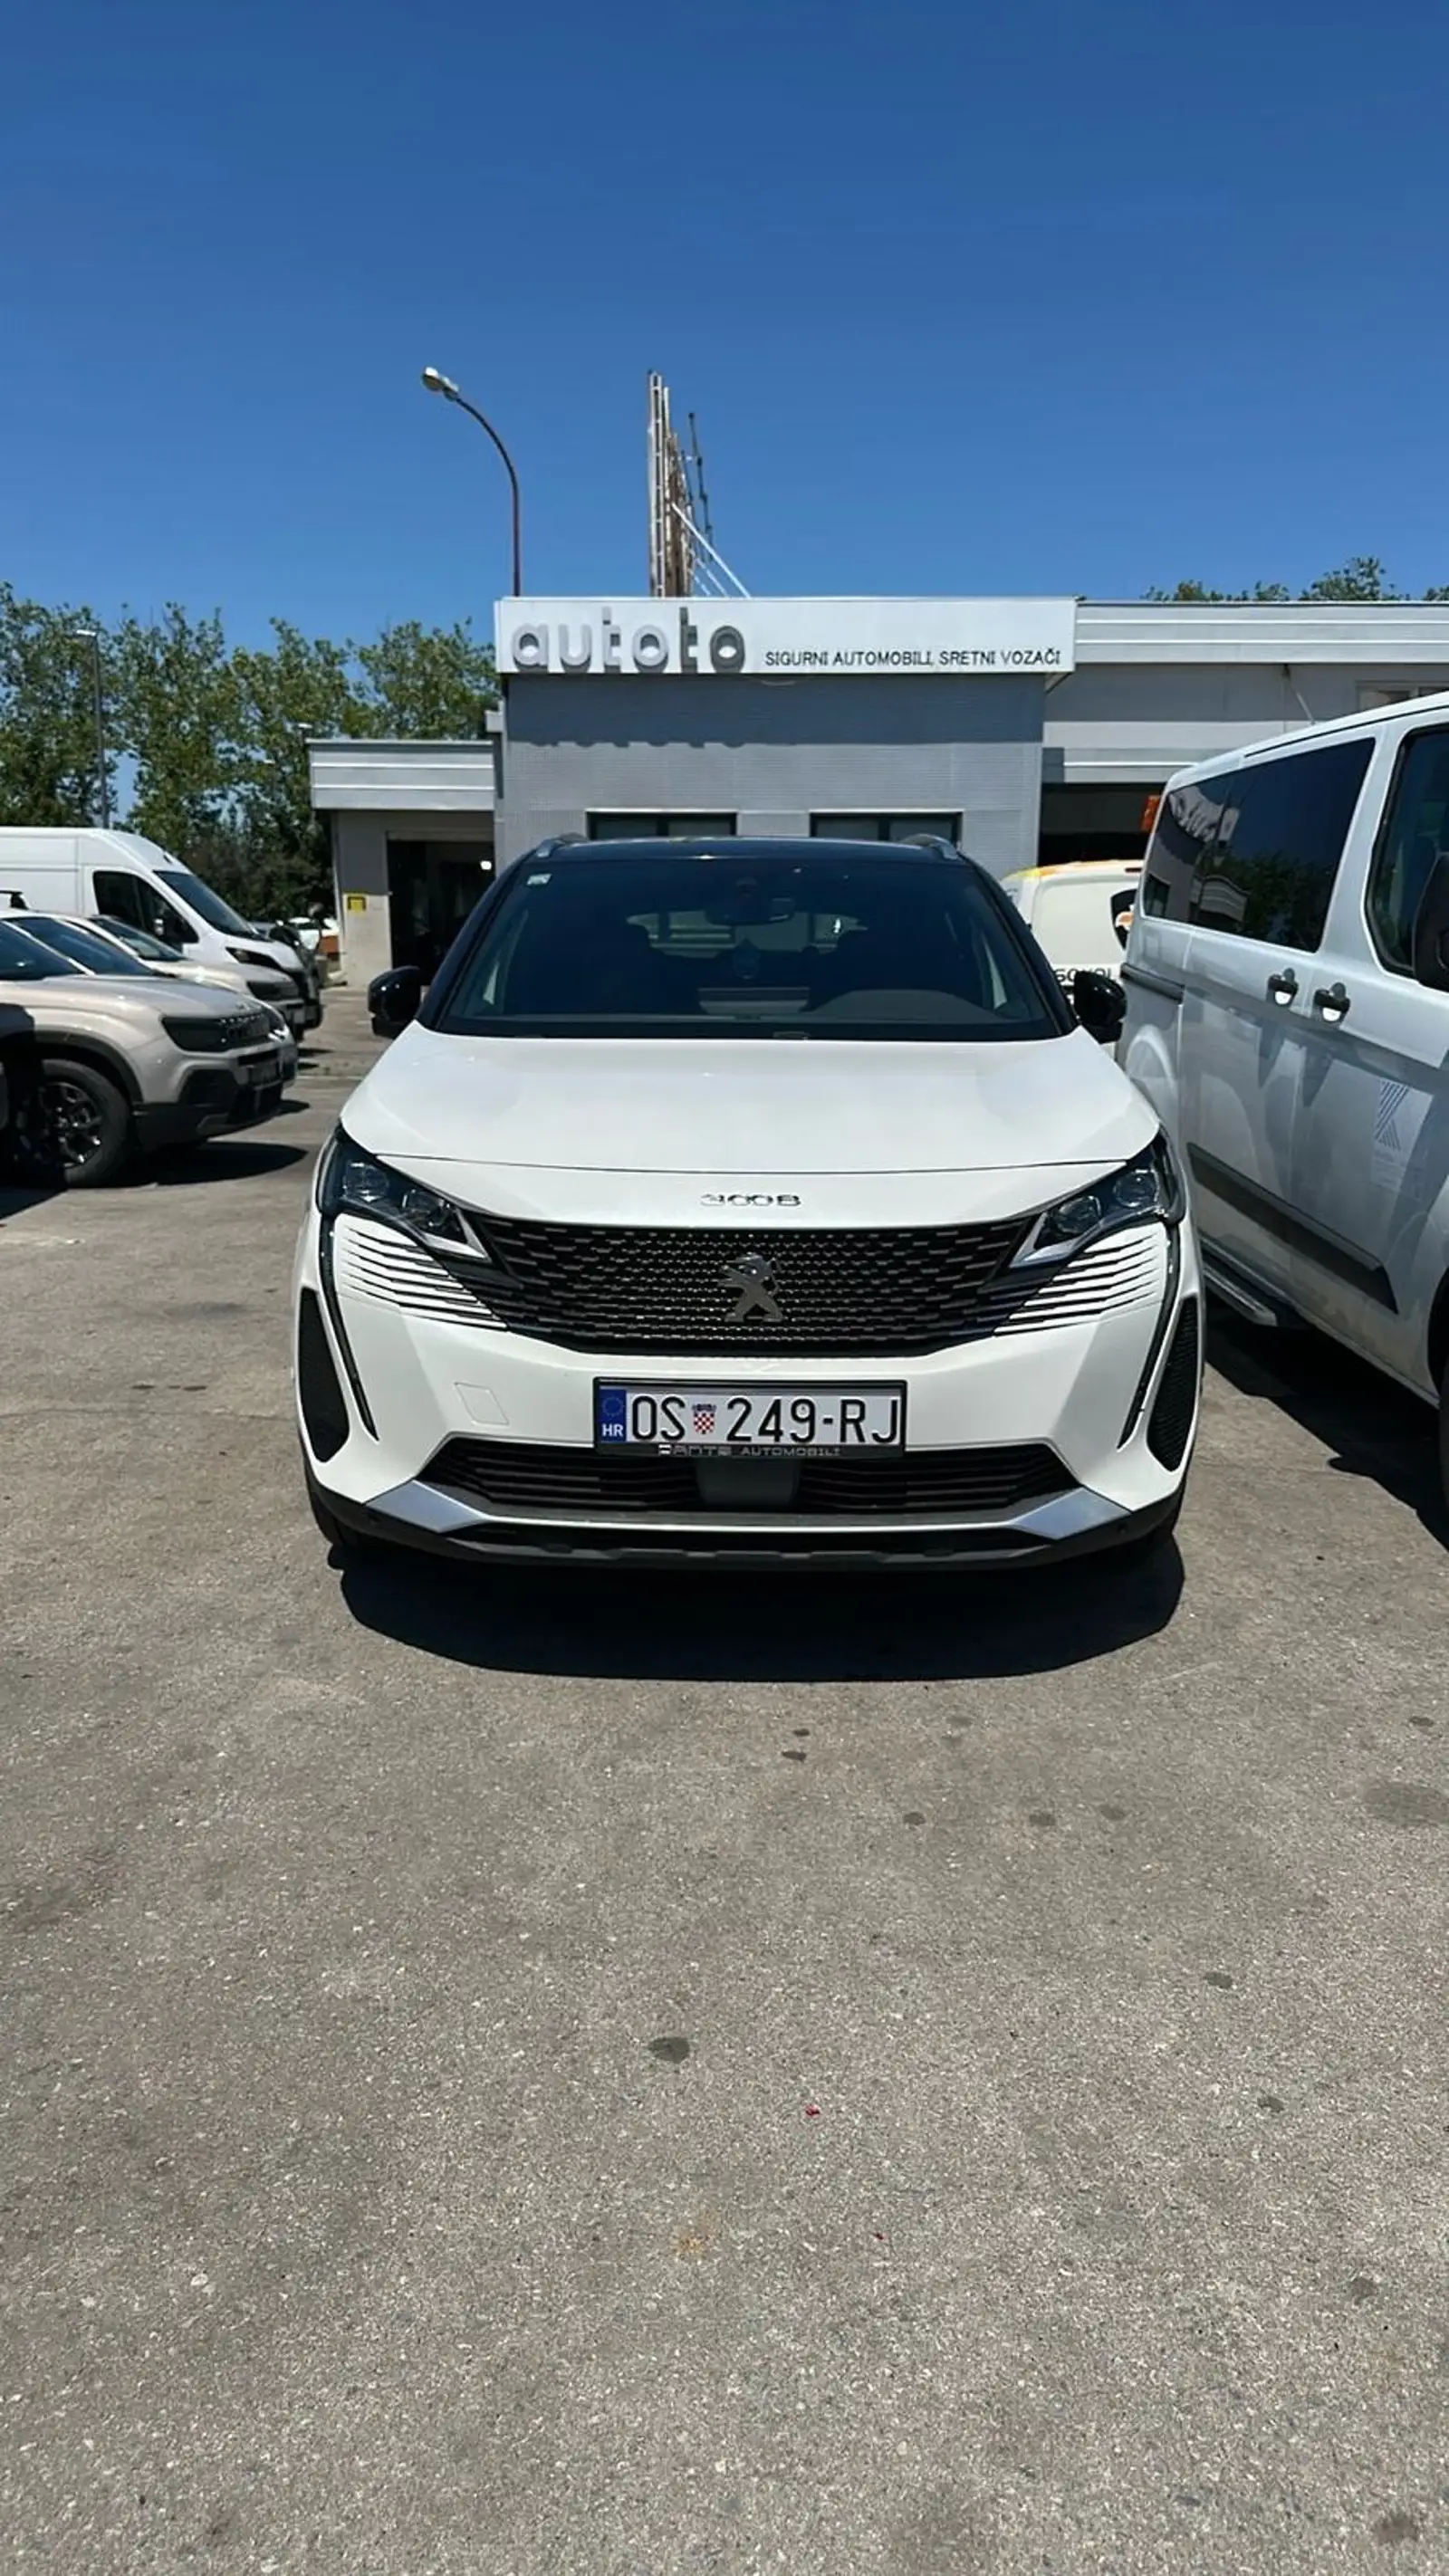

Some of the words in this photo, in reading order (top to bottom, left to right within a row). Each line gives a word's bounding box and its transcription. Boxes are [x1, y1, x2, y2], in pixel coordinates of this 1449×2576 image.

[511, 606, 746, 673] autoto
[765, 651, 829, 666] SIGURNI
[939, 650, 996, 666] SRETNI
[1000, 648, 1060, 665] VOZAČI
[700, 1193, 801, 1207] 3008
[632, 1395, 686, 1441] OS
[726, 1397, 898, 1443] 249-RJ
[601, 1423, 624, 1437] HR
[740, 1446, 840, 1457] AUTOMOBILI
